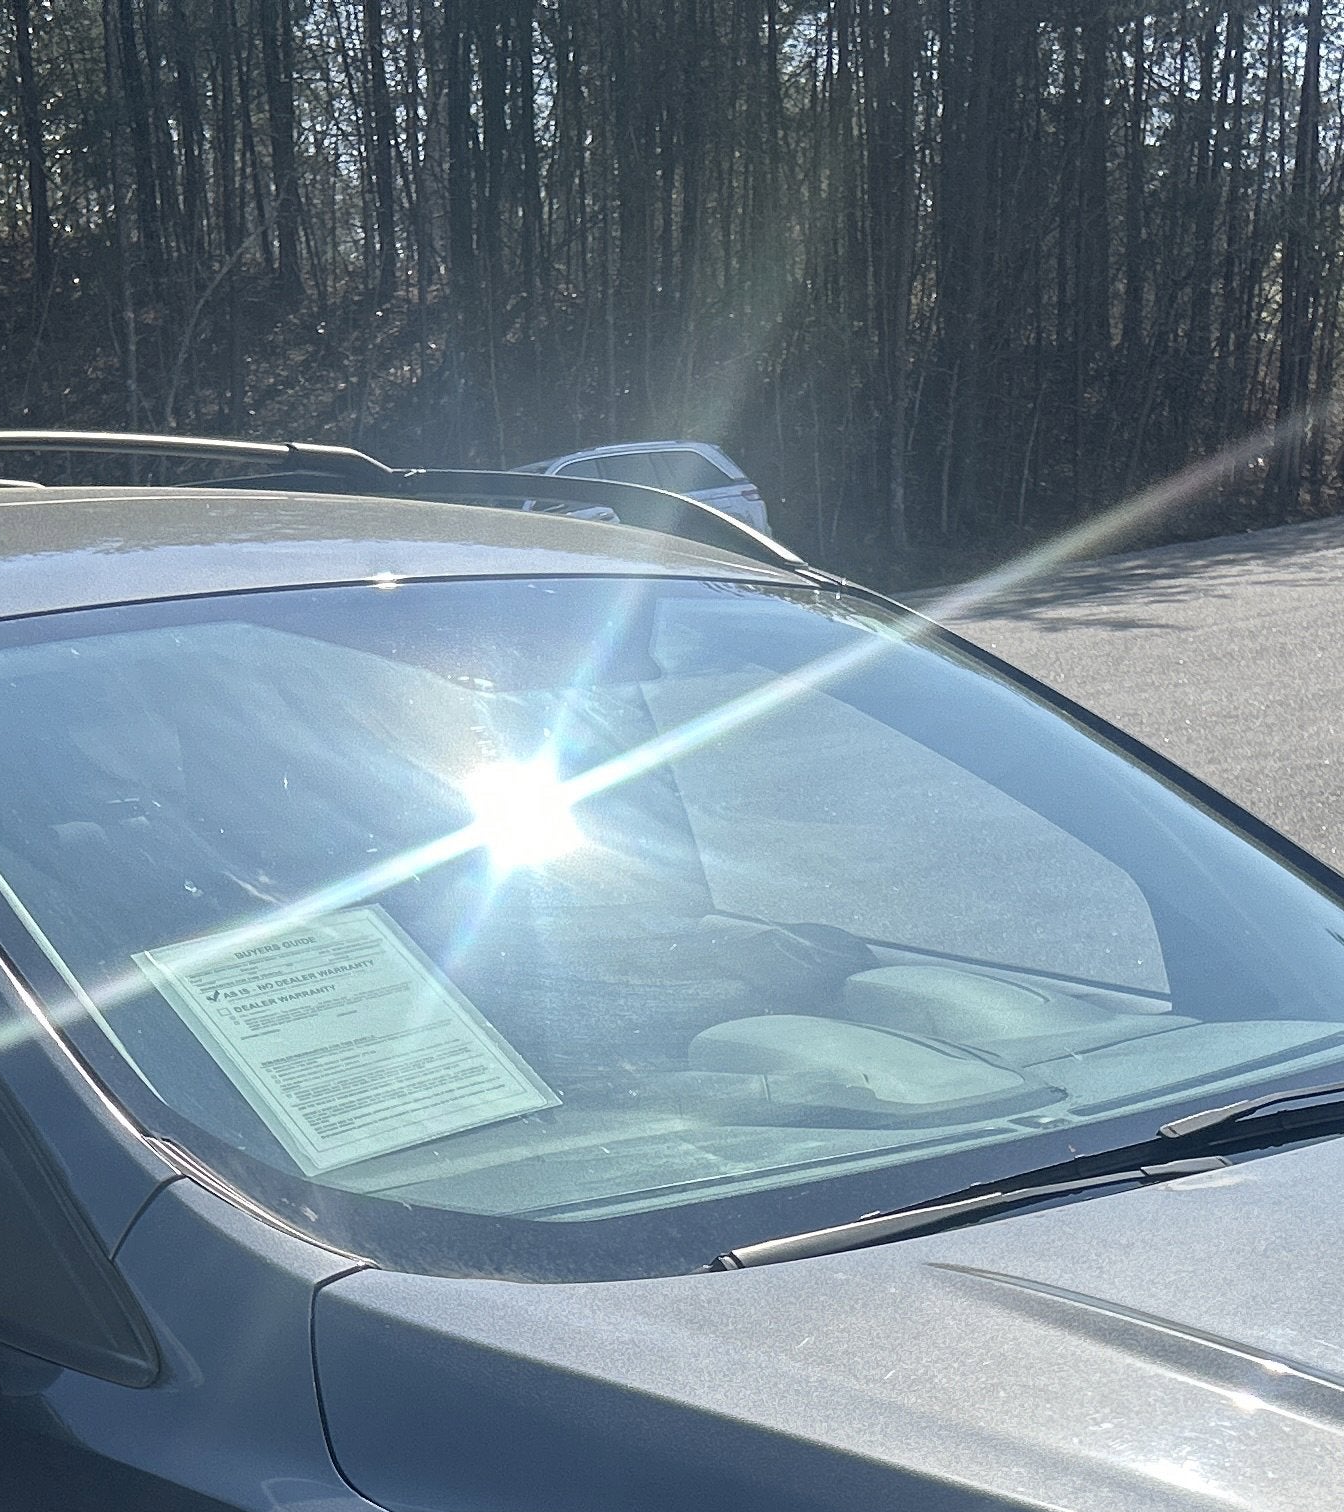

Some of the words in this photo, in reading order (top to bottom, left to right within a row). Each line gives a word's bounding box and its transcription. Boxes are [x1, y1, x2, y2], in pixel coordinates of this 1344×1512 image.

[282, 936, 317, 949] GUIDE
[223, 990, 238, 1000] AS
[238, 987, 251, 996] IS
[257, 982, 274, 992] NO
[275, 972, 317, 987] DEALER
[317, 959, 374, 977] WARRANTY
[233, 999, 278, 1013] DEALER
[279, 984, 336, 1002] WARRANTY
